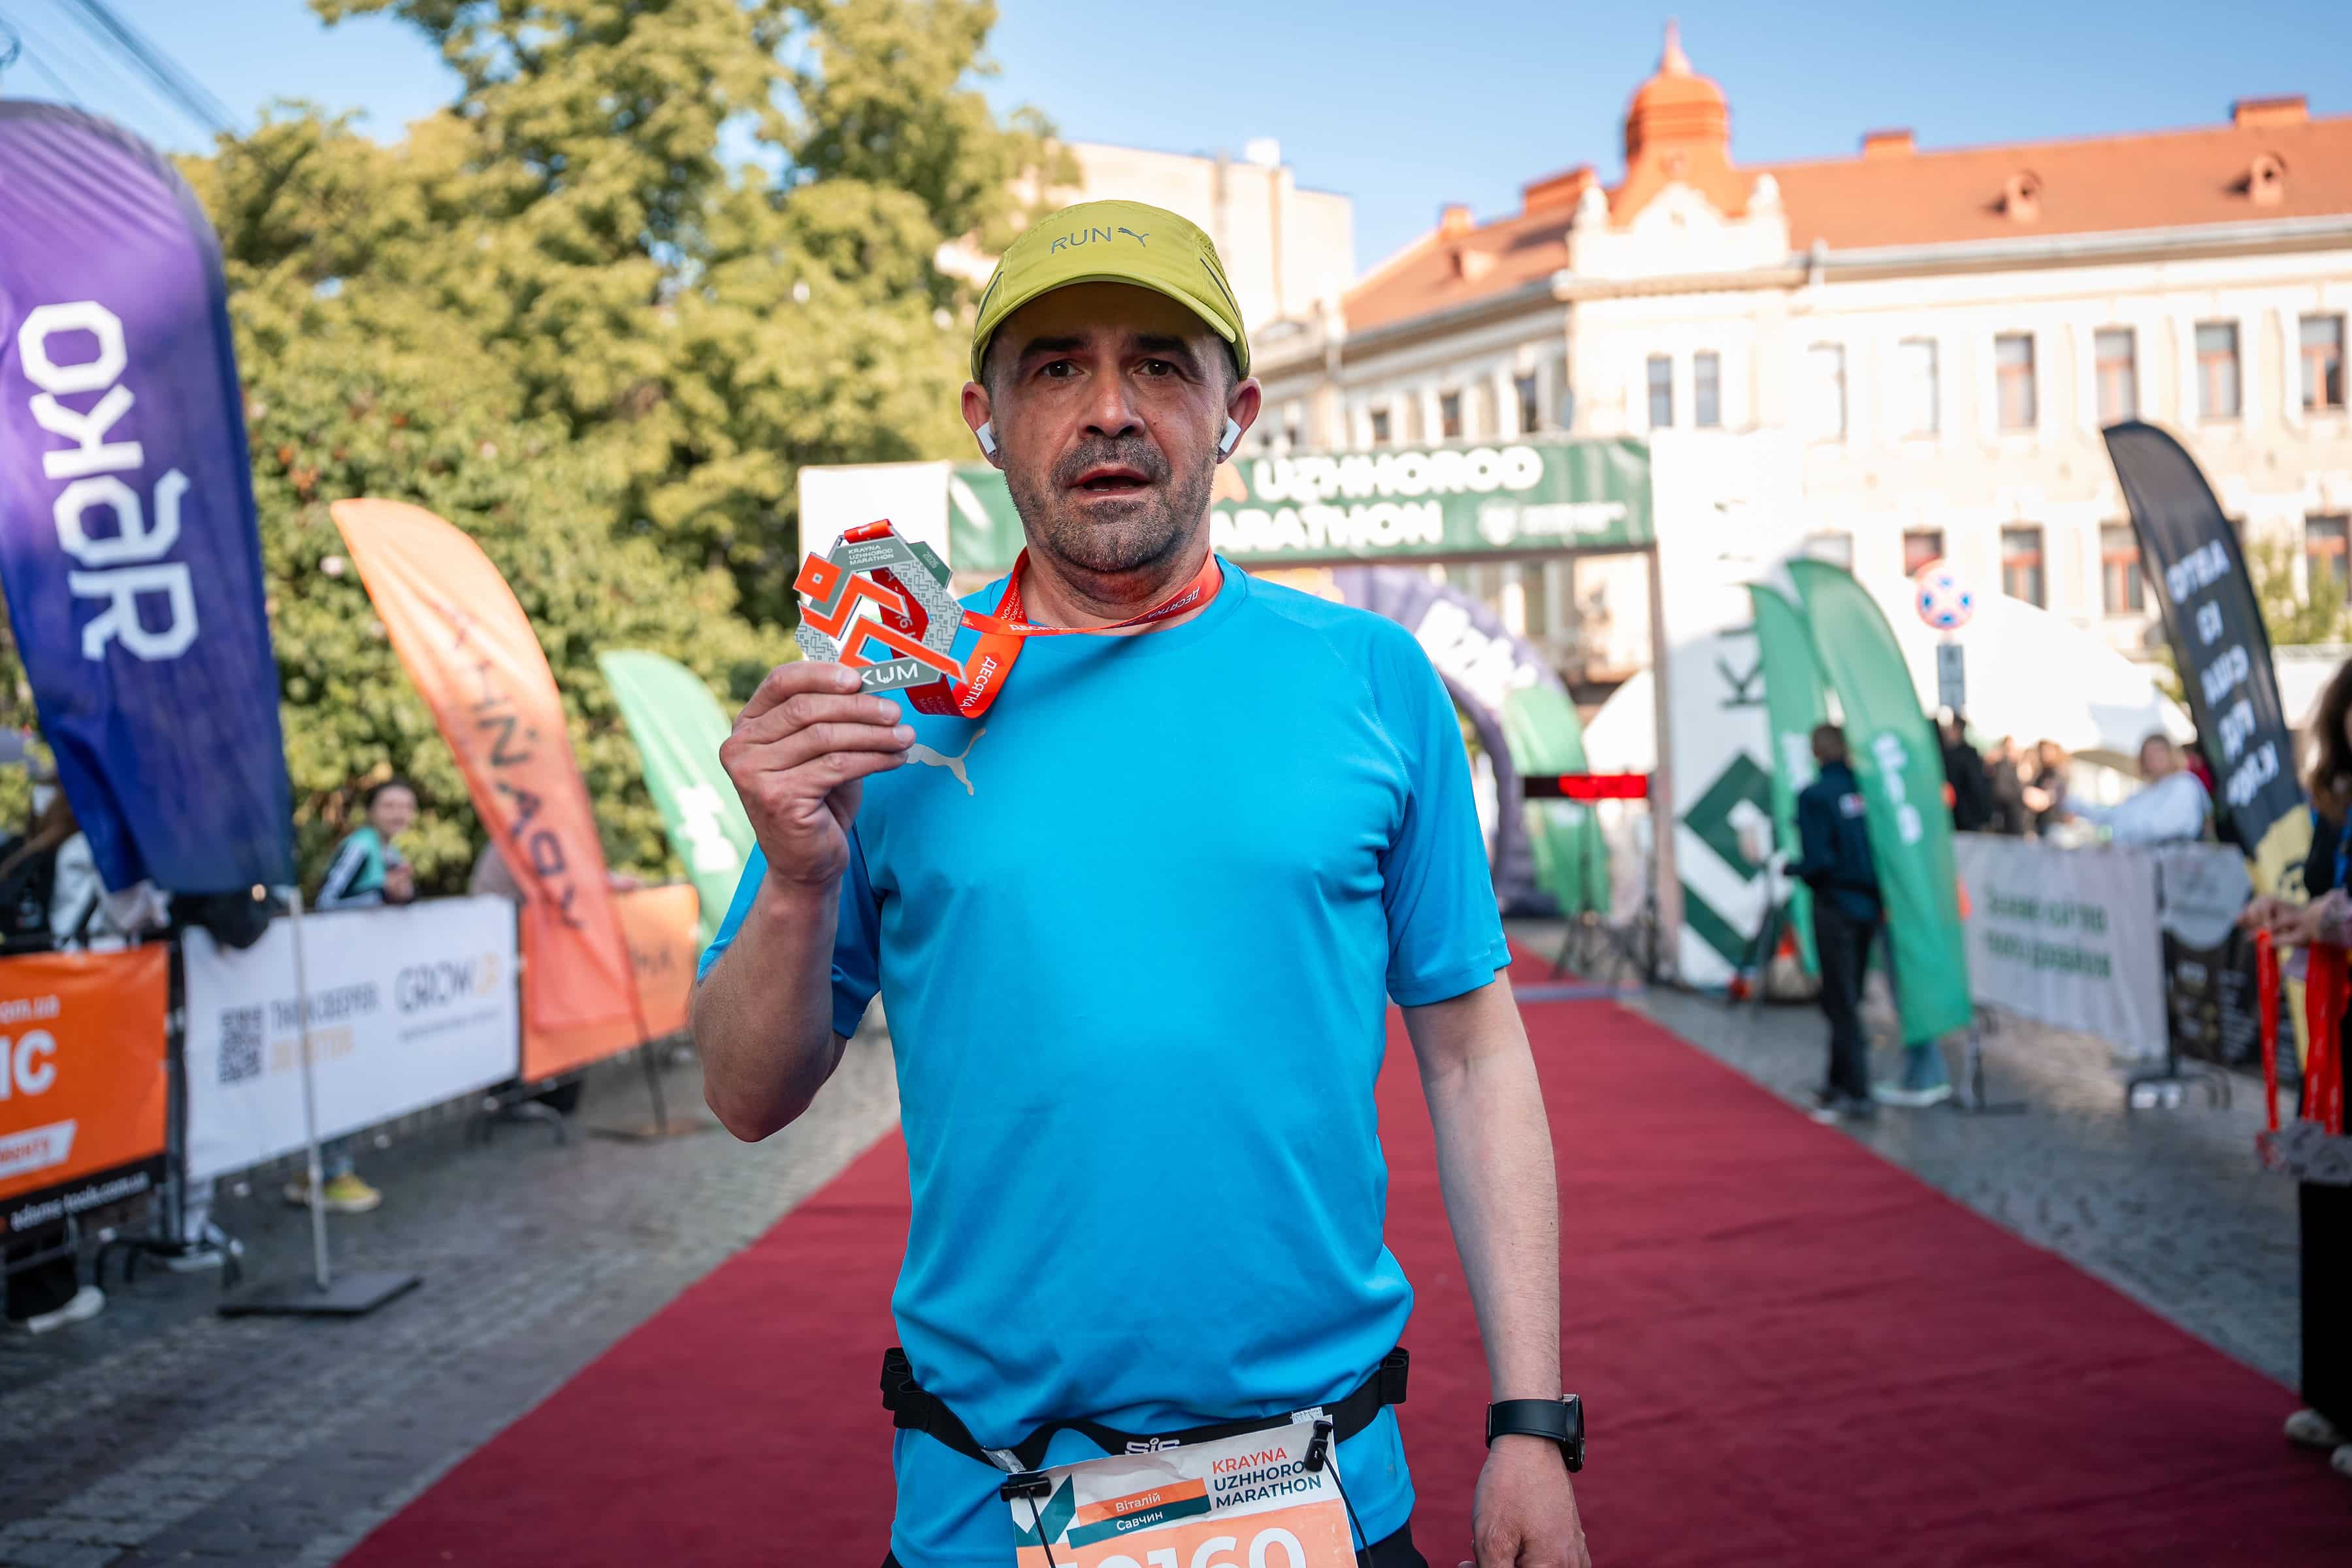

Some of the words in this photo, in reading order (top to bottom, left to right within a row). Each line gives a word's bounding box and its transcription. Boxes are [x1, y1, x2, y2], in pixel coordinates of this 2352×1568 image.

[1051, 226, 1112, 255] RUN
[1210, 500, 1444, 553] ARATHON
[848, 544, 881, 555] KRAYNA
[849, 548, 893, 561] UZHHOROD
[849, 553, 894, 565] MARATHON
[959, 655, 998, 708] ДЕСЯТКА
[1212, 1447, 1288, 1475] KRAYNA
[1214, 1460, 1305, 1492] UZHHORO
[1115, 1492, 1162, 1512] Віталій
[1216, 1475, 1322, 1509] MARATHON
[1116, 1511, 1164, 1531] Савчин
